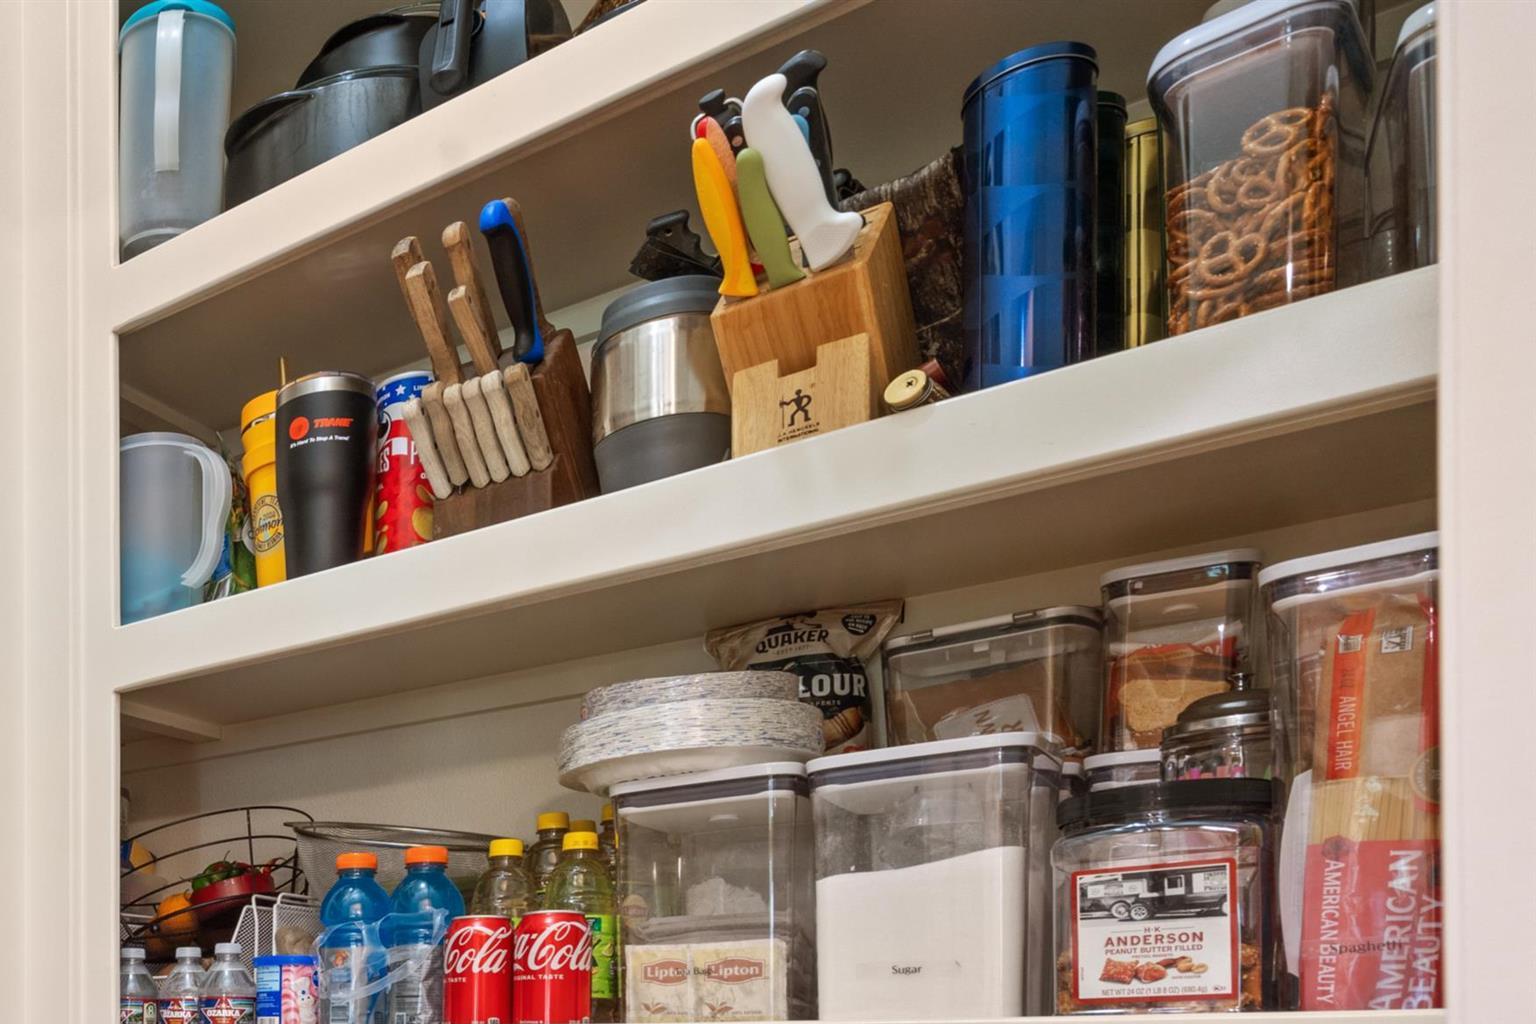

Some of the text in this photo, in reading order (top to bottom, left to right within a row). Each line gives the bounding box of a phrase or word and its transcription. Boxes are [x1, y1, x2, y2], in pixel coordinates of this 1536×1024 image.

[755, 629, 829, 655] QUAKER
[1334, 696, 1357, 772] ANGEL HAIR
[1104, 931, 1205, 947] ANDERSON
[1315, 859, 1341, 1005] AMERICAN BEAUTY
[1367, 849, 1425, 1010] AMERICAN
[1104, 943, 1204, 956] PEANUT BUTTER FILLED
[1400, 894, 1445, 1010] BEAUTY
[710, 962, 760, 978] Lipton
[890, 963, 923, 978] Sugar
[206, 1009, 241, 1018] OZARKA
